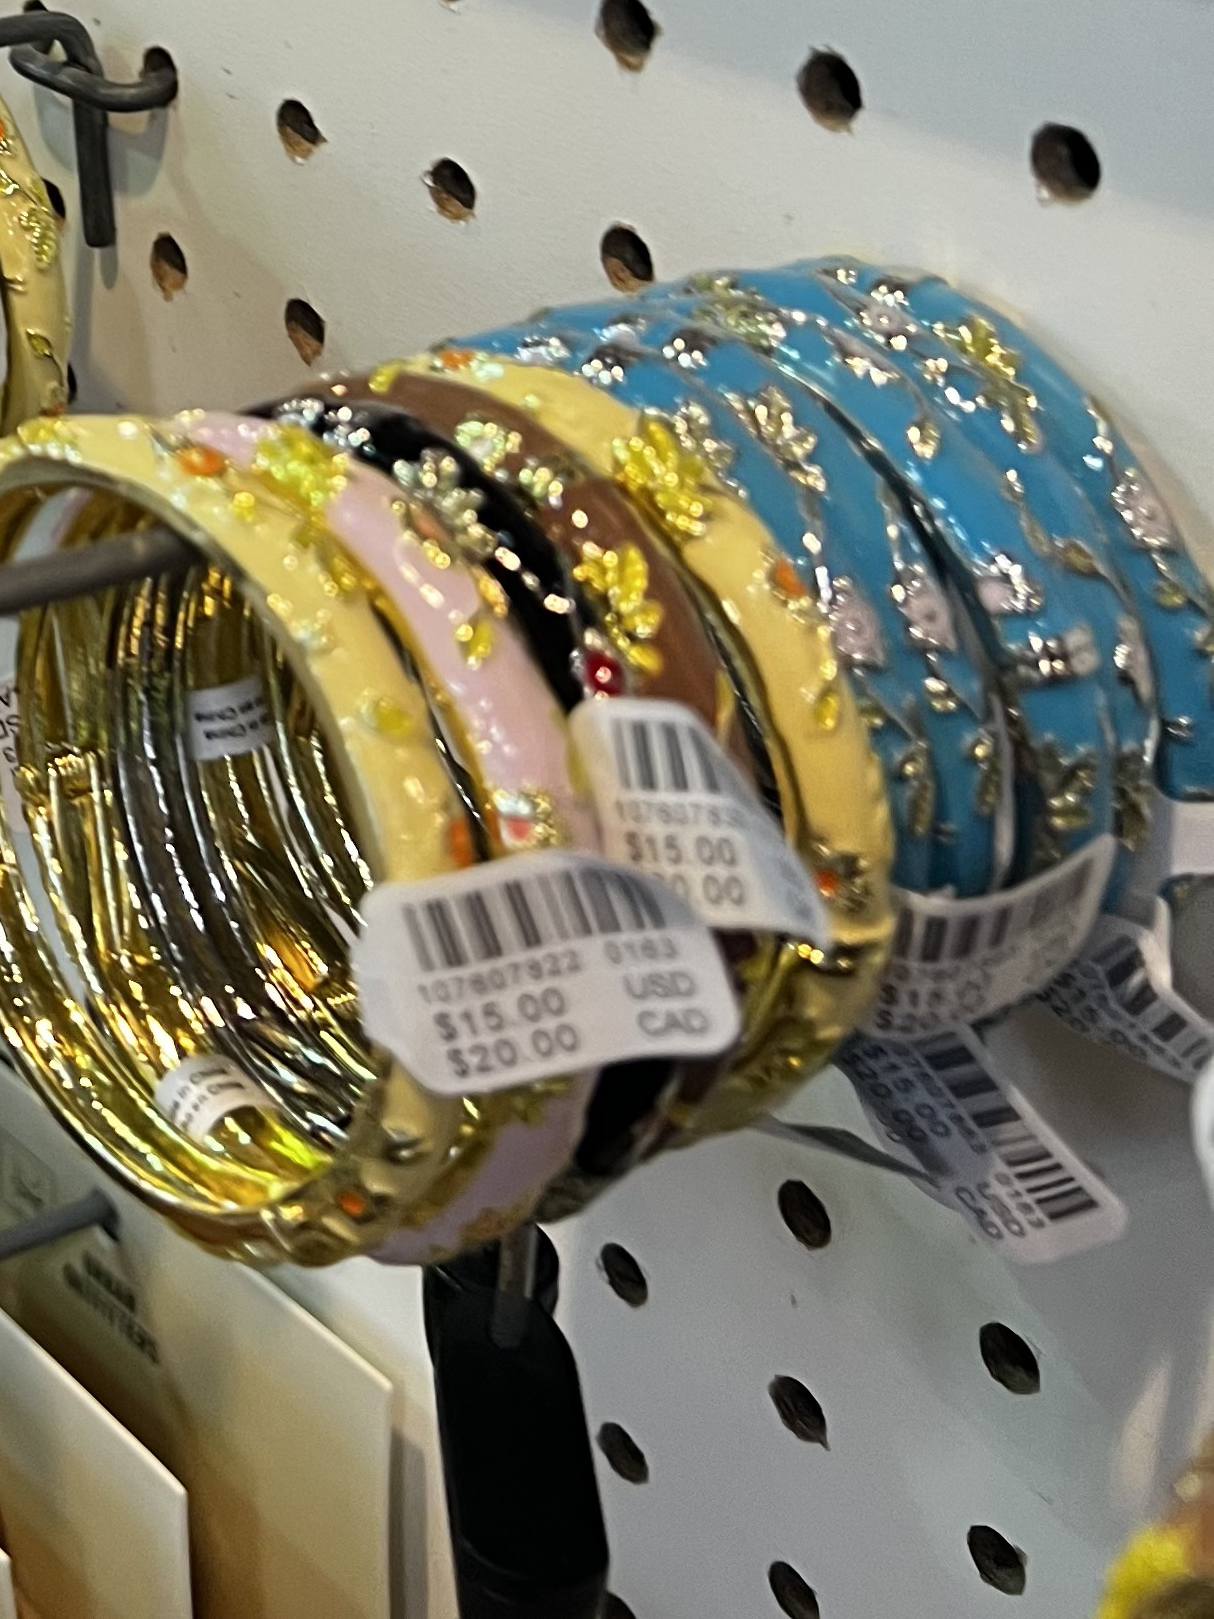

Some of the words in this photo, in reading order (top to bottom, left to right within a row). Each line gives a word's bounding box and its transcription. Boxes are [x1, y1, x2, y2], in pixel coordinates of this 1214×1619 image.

[625, 832, 738, 867] $15.00
[433, 987, 566, 1042] $15.00
[622, 969, 697, 1001] USD
[446, 1023, 580, 1078] $20.00
[637, 1008, 710, 1038] CAD
